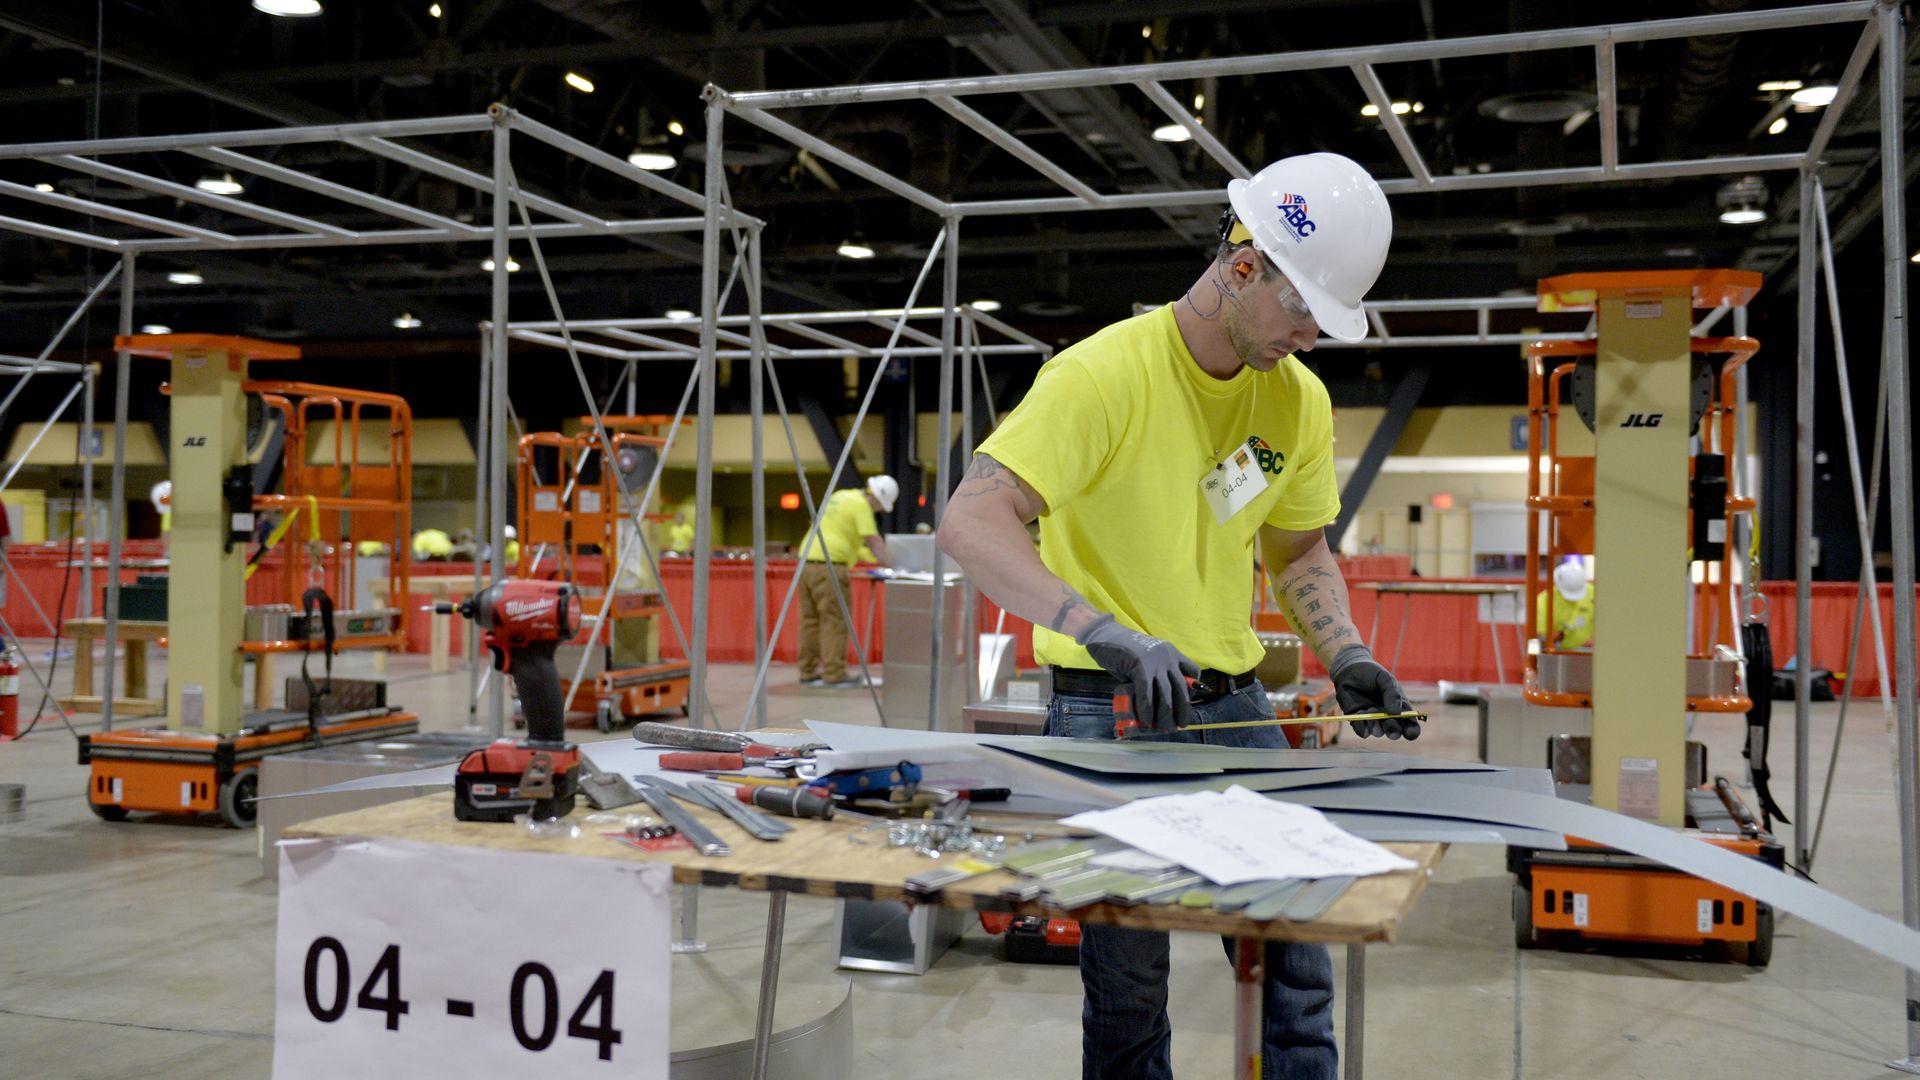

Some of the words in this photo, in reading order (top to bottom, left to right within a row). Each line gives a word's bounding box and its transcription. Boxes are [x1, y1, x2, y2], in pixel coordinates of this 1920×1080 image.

[1277, 204, 1316, 237] ABC
[1620, 413, 1663, 428] JLG
[182, 436, 207, 447] JLG
[1221, 473, 1248, 498] 04-04
[303, 936, 409, 1031] 04
[446, 998, 474, 1018] -
[510, 961, 622, 1061] 04
